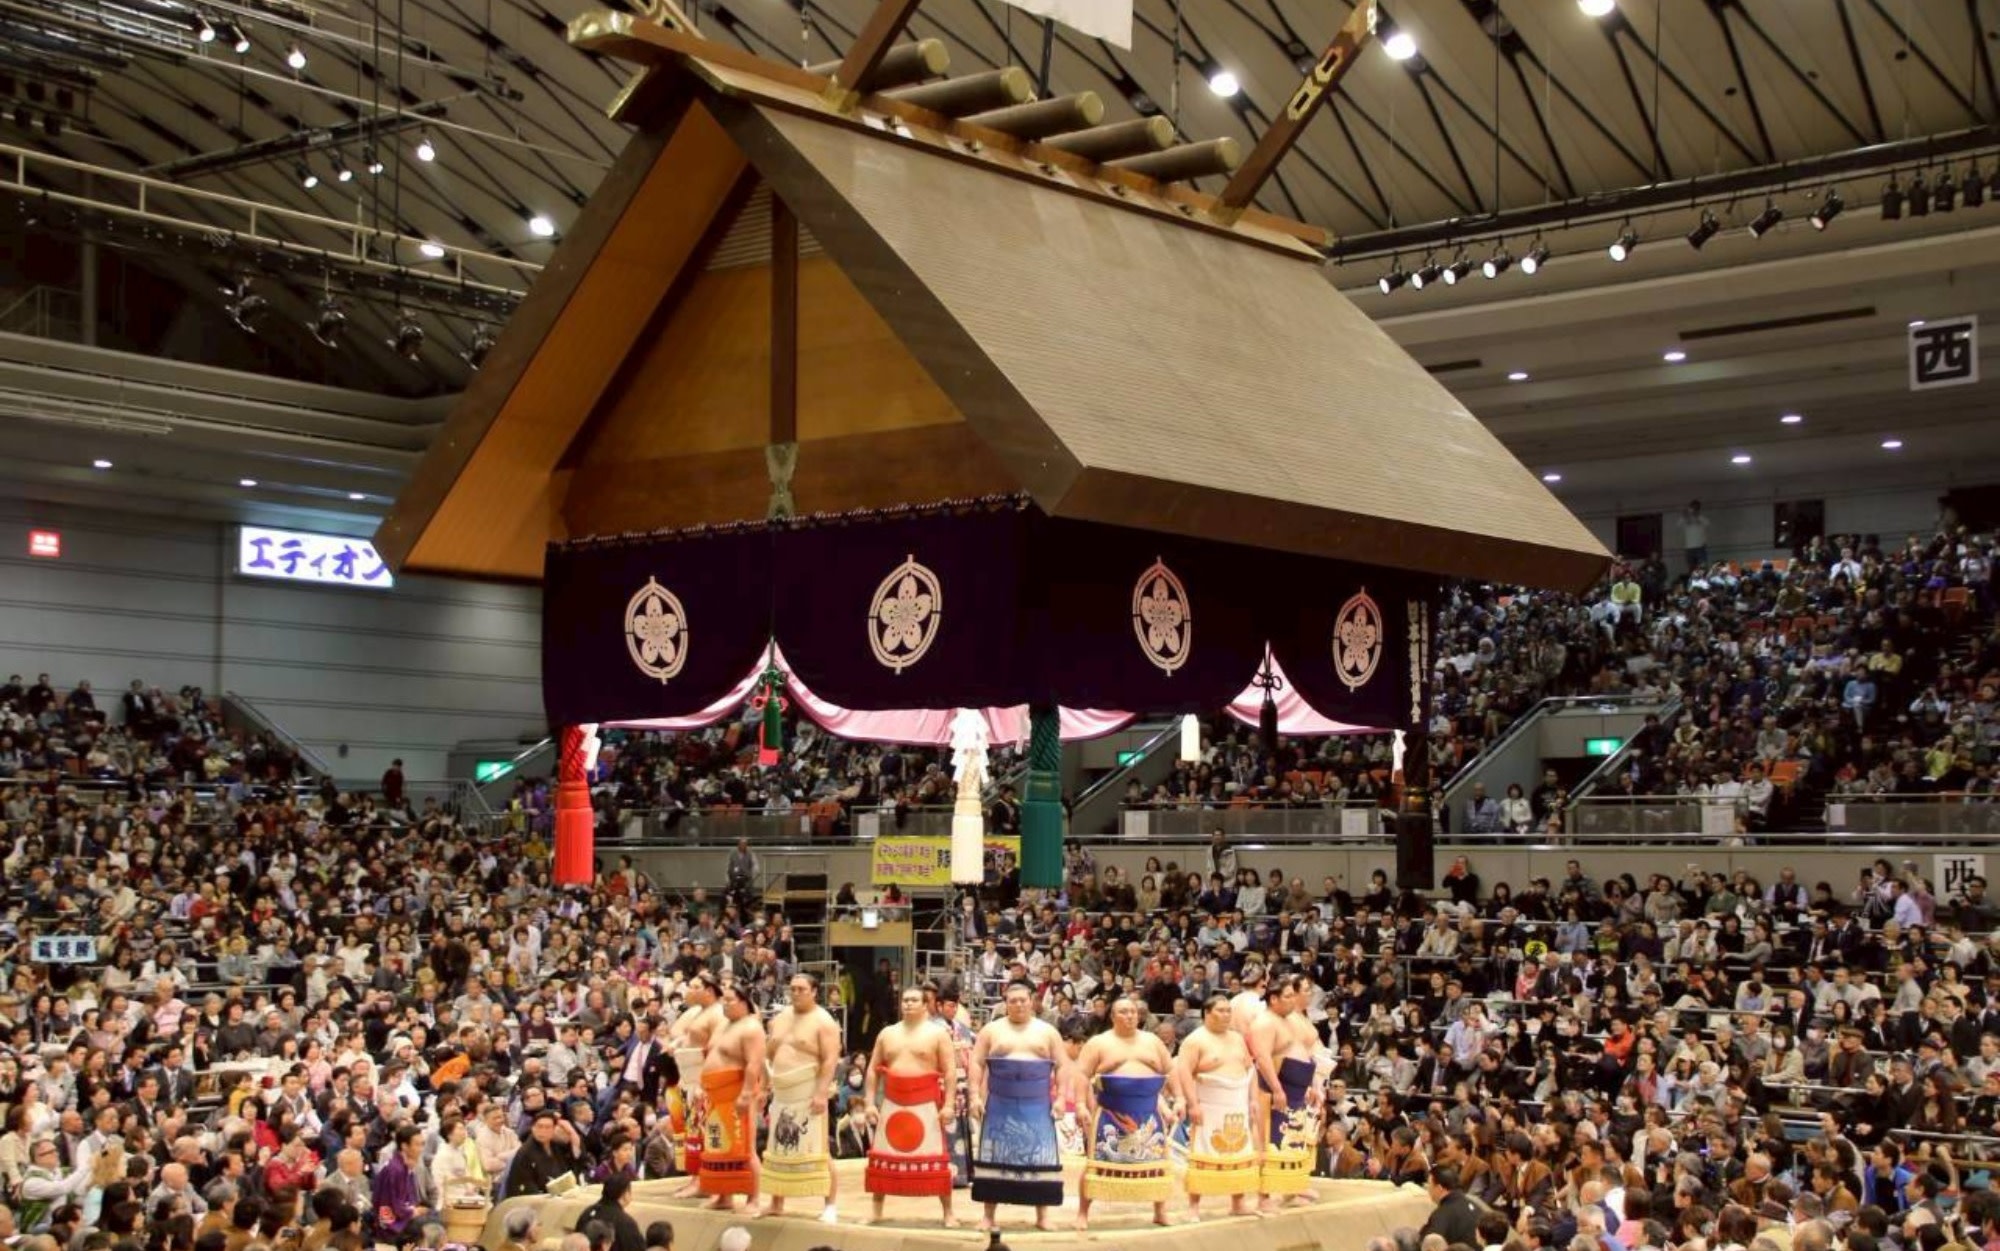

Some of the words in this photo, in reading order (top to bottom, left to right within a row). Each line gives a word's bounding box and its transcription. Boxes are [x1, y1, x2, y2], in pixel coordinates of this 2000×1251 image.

[1913, 322, 1972, 384] 西
[247, 537, 388, 581] エディオン
[1942, 857, 1977, 893] 西
